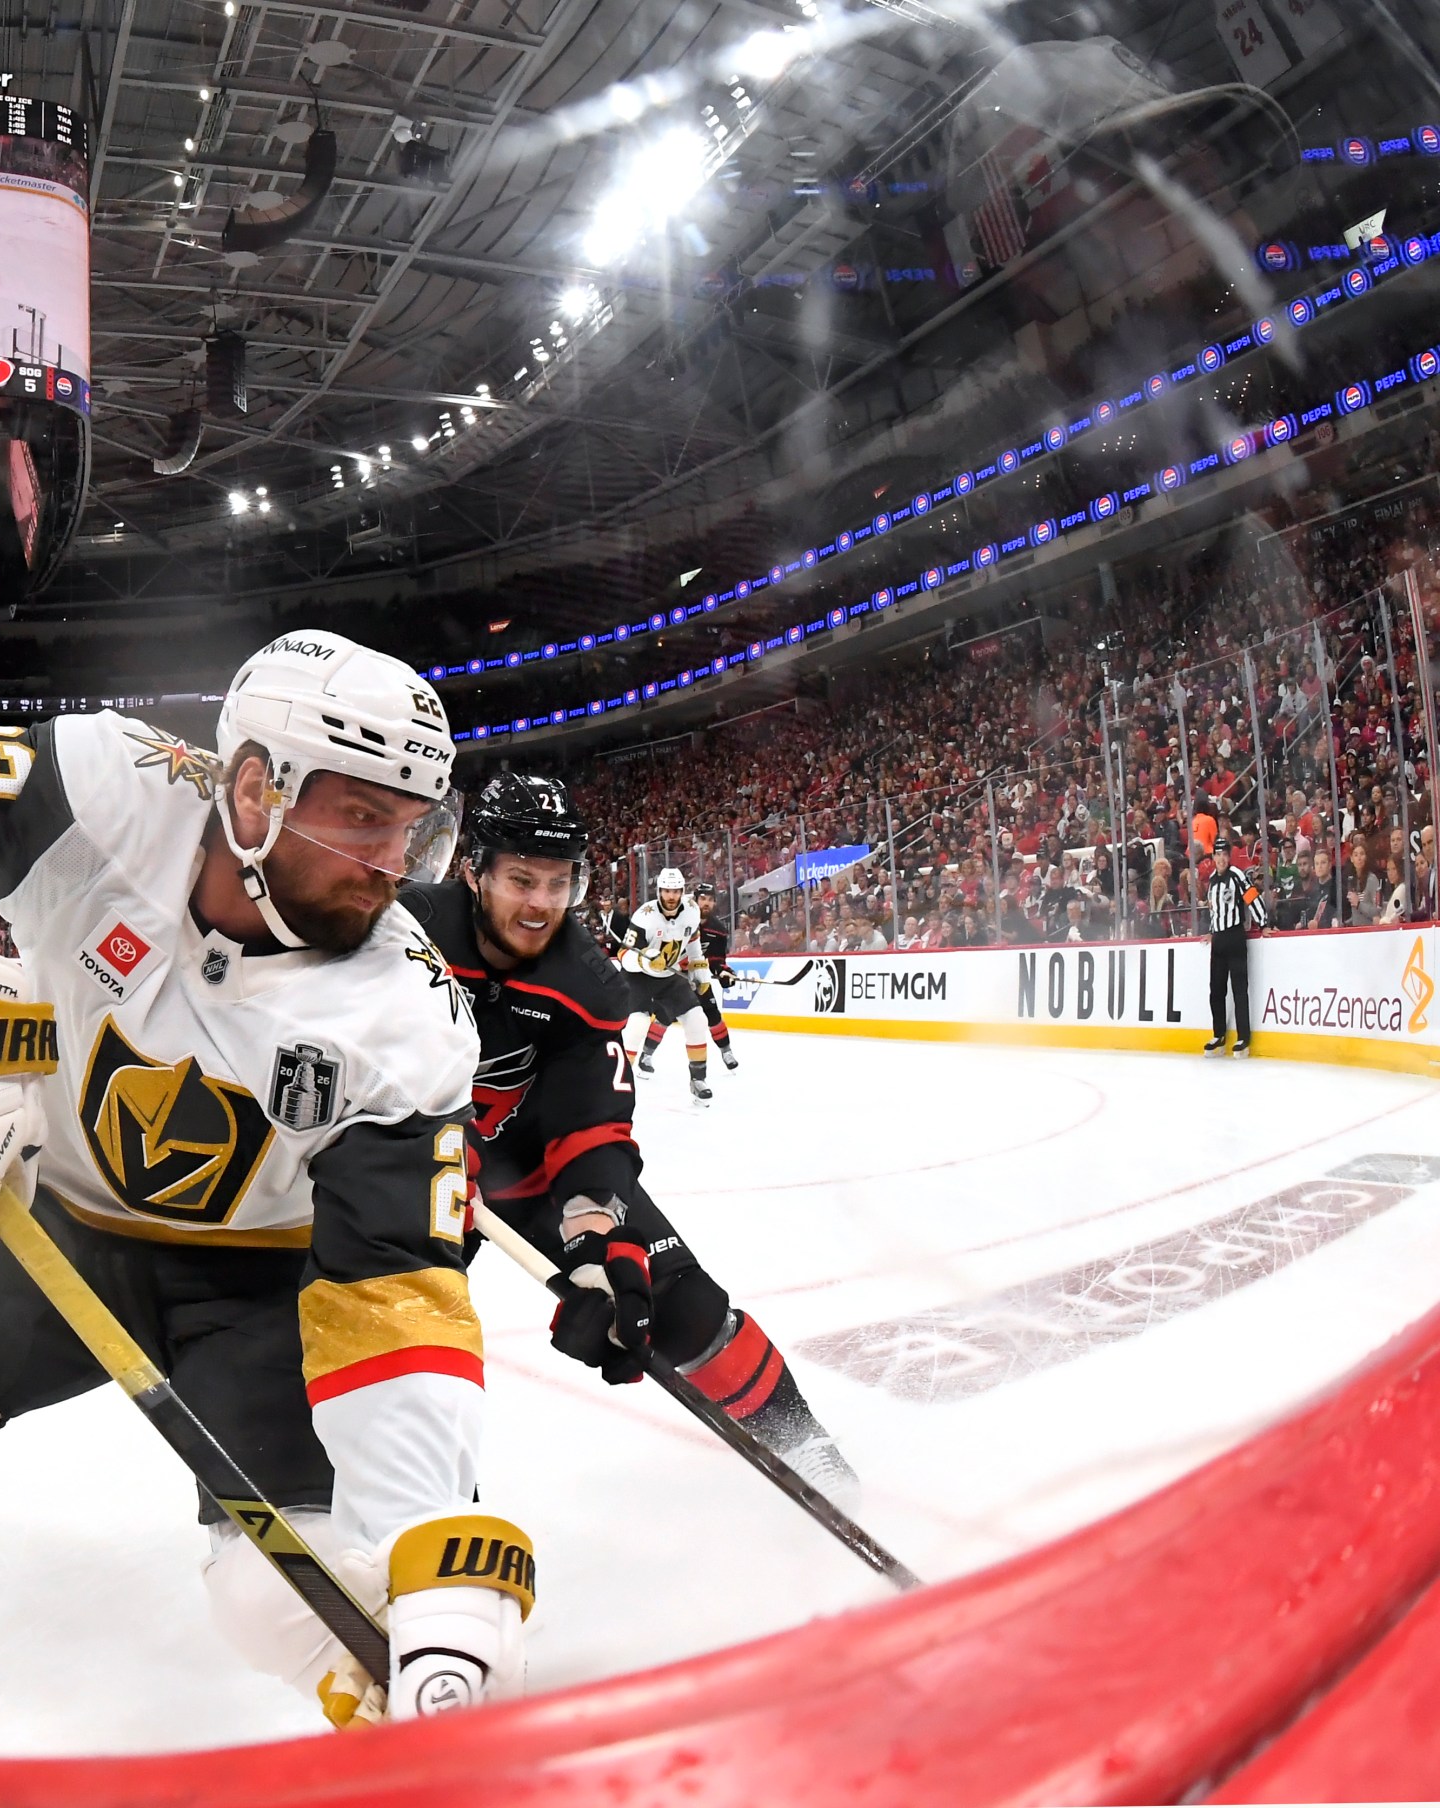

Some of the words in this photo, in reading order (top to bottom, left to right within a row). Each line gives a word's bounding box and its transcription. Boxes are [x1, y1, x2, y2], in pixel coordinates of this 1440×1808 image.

[1233, 18, 1264, 56] 24
[5, 95, 17, 103] ON
[18, 97, 32, 105] ICE
[19, 367, 41, 377] SOG
[975, 466, 996, 480] PEPSI
[1020, 443, 1042, 458] PEPSI
[1069, 417, 1091, 434] PEPSI
[1120, 391, 1142, 408] PEPSI
[1172, 364, 1196, 382] PEPSI
[1226, 336, 1251, 354] PEPSI
[1316, 288, 1342, 306] PEPSI
[1374, 255, 1402, 274] PEPSI
[25, 379, 36, 392] 5
[850, 601, 870, 616] PEPSI
[896, 582, 918, 596] PEPSI
[948, 560, 970, 575] PEPSI
[1002, 537, 1026, 553] PEPSI
[1060, 512, 1086, 529] PEPSI
[1123, 484, 1150, 502] PEPSI
[1190, 454, 1219, 474] PEPSI
[1301, 404, 1332, 425] PEPSI
[1375, 370, 1406, 392] PEPSI
[403, 739, 450, 764] CCM
[534, 829, 571, 840] BAUER
[79, 950, 124, 998] TOYOTA
[205, 960, 225, 975] NHL
[723, 969, 760, 1001] SAP
[851, 972, 947, 1000] BETMGM
[1018, 948, 1182, 1023] NOBULL
[511, 1005, 551, 1022] NUCOR
[1262, 987, 1402, 1031] AstraZeneca
[280, 1066, 293, 1077] 20
[317, 1075, 330, 1085] 26
[606, 1041, 632, 1093] 2
